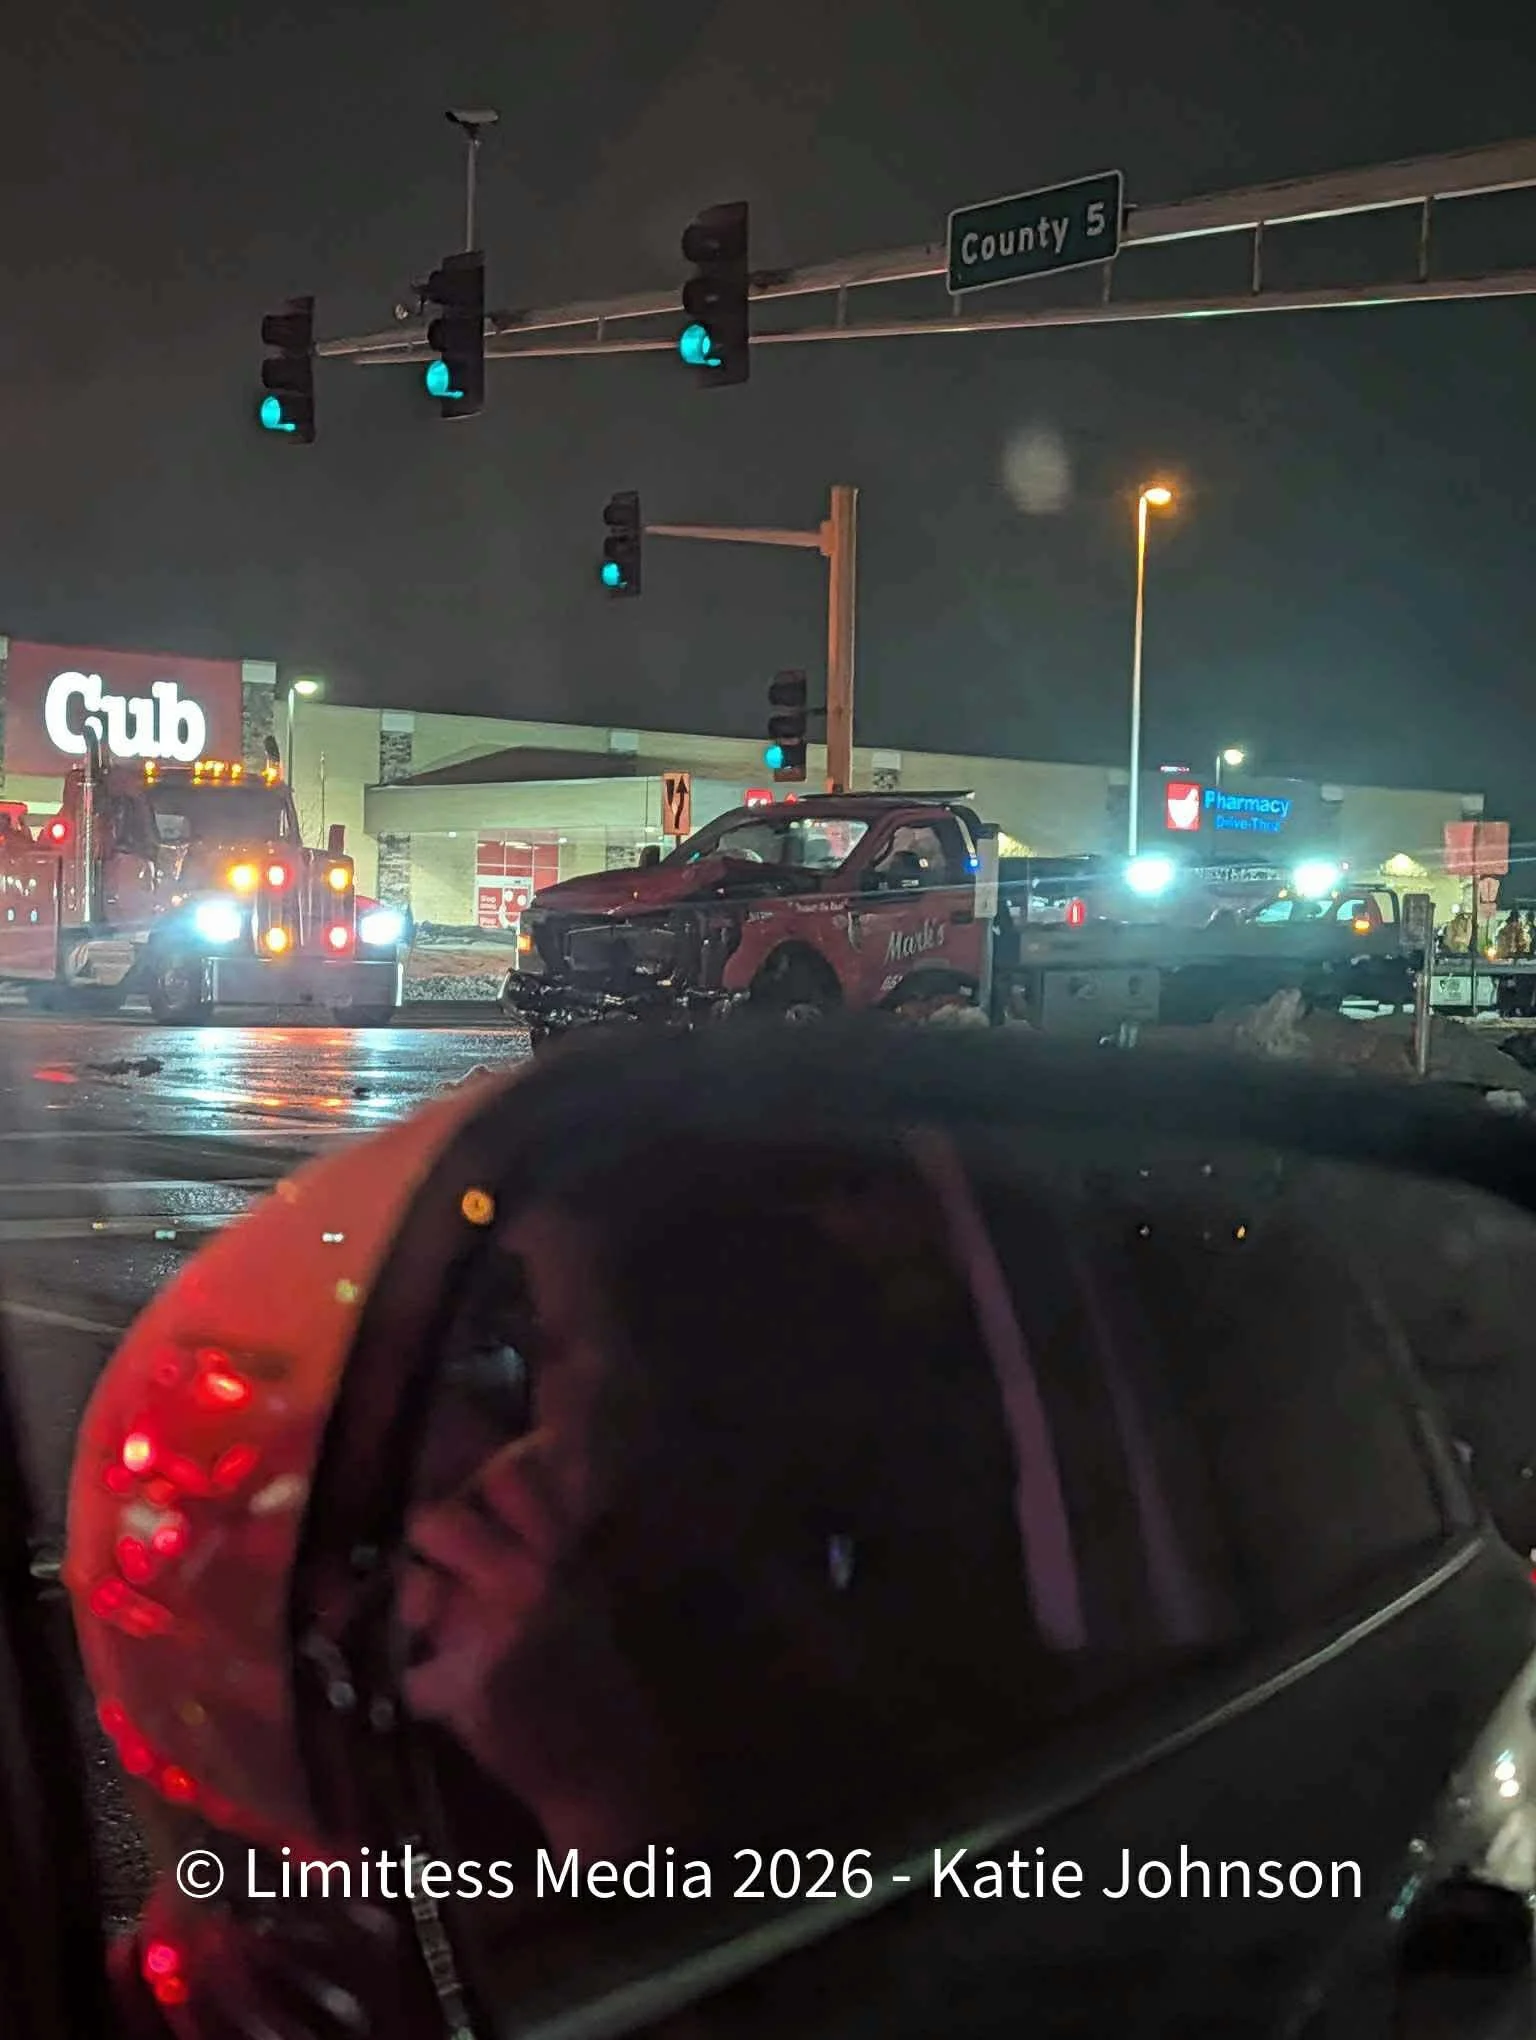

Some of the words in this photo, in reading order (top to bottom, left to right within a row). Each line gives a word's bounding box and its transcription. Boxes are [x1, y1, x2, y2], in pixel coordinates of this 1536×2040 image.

[960, 216, 1069, 265] County
[1085, 201, 1106, 236] 5
[45, 671, 206, 762] Cub
[1204, 789, 1290, 818] Pharmacy
[1215, 814, 1280, 832] Drive-Thru
